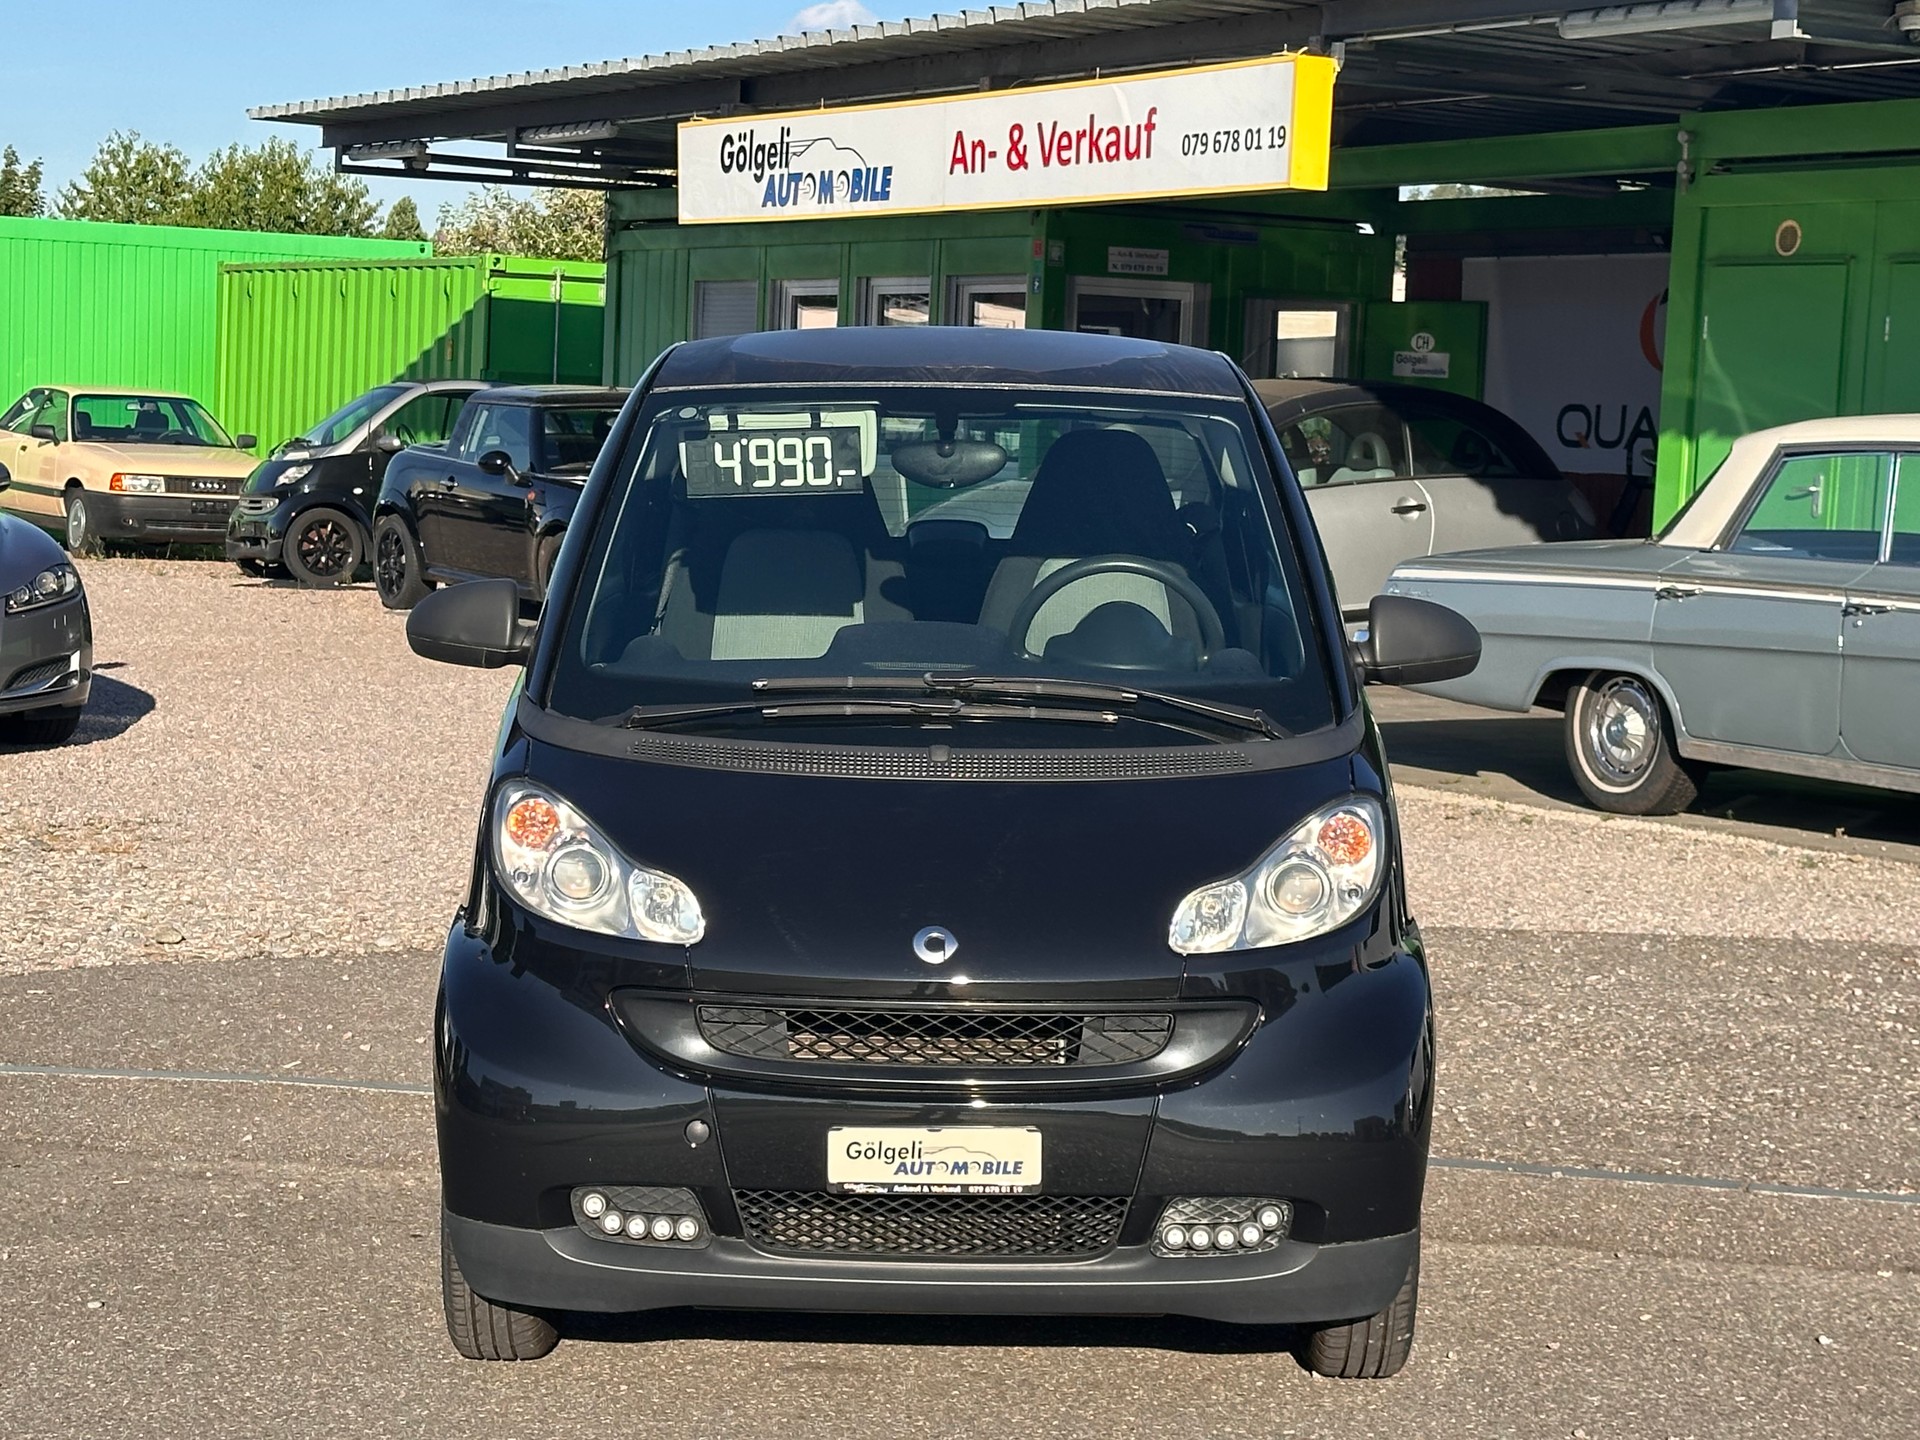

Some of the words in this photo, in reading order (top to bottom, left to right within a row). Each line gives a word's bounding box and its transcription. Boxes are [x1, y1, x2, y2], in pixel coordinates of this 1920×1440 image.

[720, 126, 791, 183] Gölgeli
[949, 130, 997, 175] An-
[1006, 123, 1029, 171] &
[1037, 107, 1157, 168] Verkauf
[1182, 132, 1208, 156] 079
[1213, 130, 1240, 154] 678
[1244, 128, 1262, 151] 01
[1267, 125, 1286, 149] 19
[761, 166, 893, 208] AUTOMOBILE
[1415, 335, 1430, 350] CH
[846, 1141, 923, 1164] Gölgeli
[893, 1161, 1024, 1176] AUTOMOBILE
